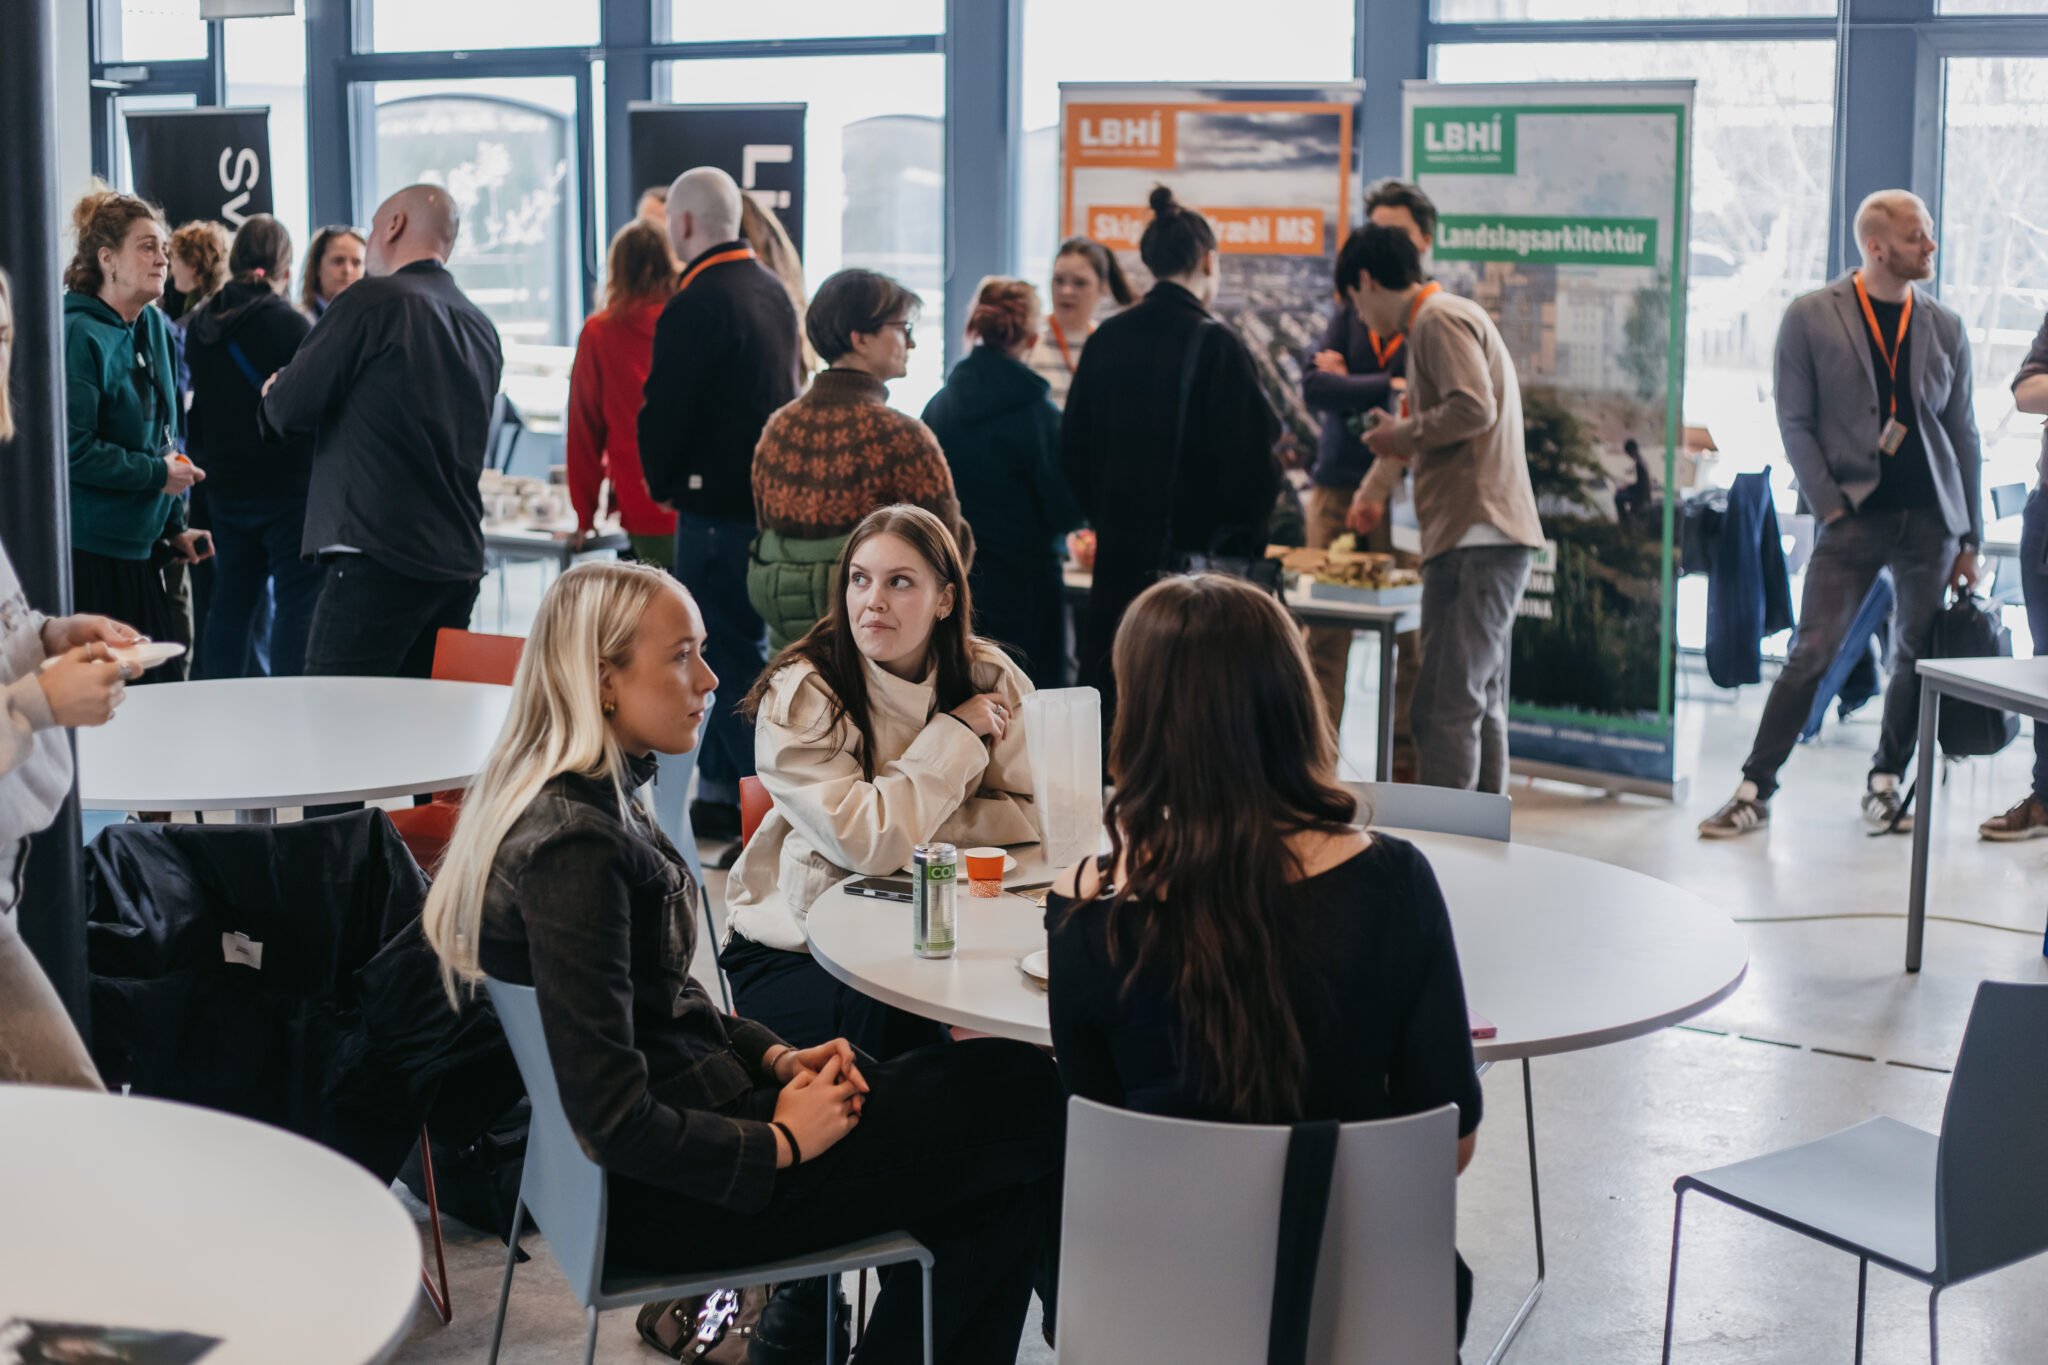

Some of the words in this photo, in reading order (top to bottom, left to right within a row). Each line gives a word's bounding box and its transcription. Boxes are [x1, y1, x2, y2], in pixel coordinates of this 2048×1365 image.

[1080, 110, 1161, 147] LBHÍ
[1424, 113, 1502, 152] LBHÍ
[1276, 215, 1316, 245] MS
[1436, 223, 1647, 257] Landslagsarkitektúr
